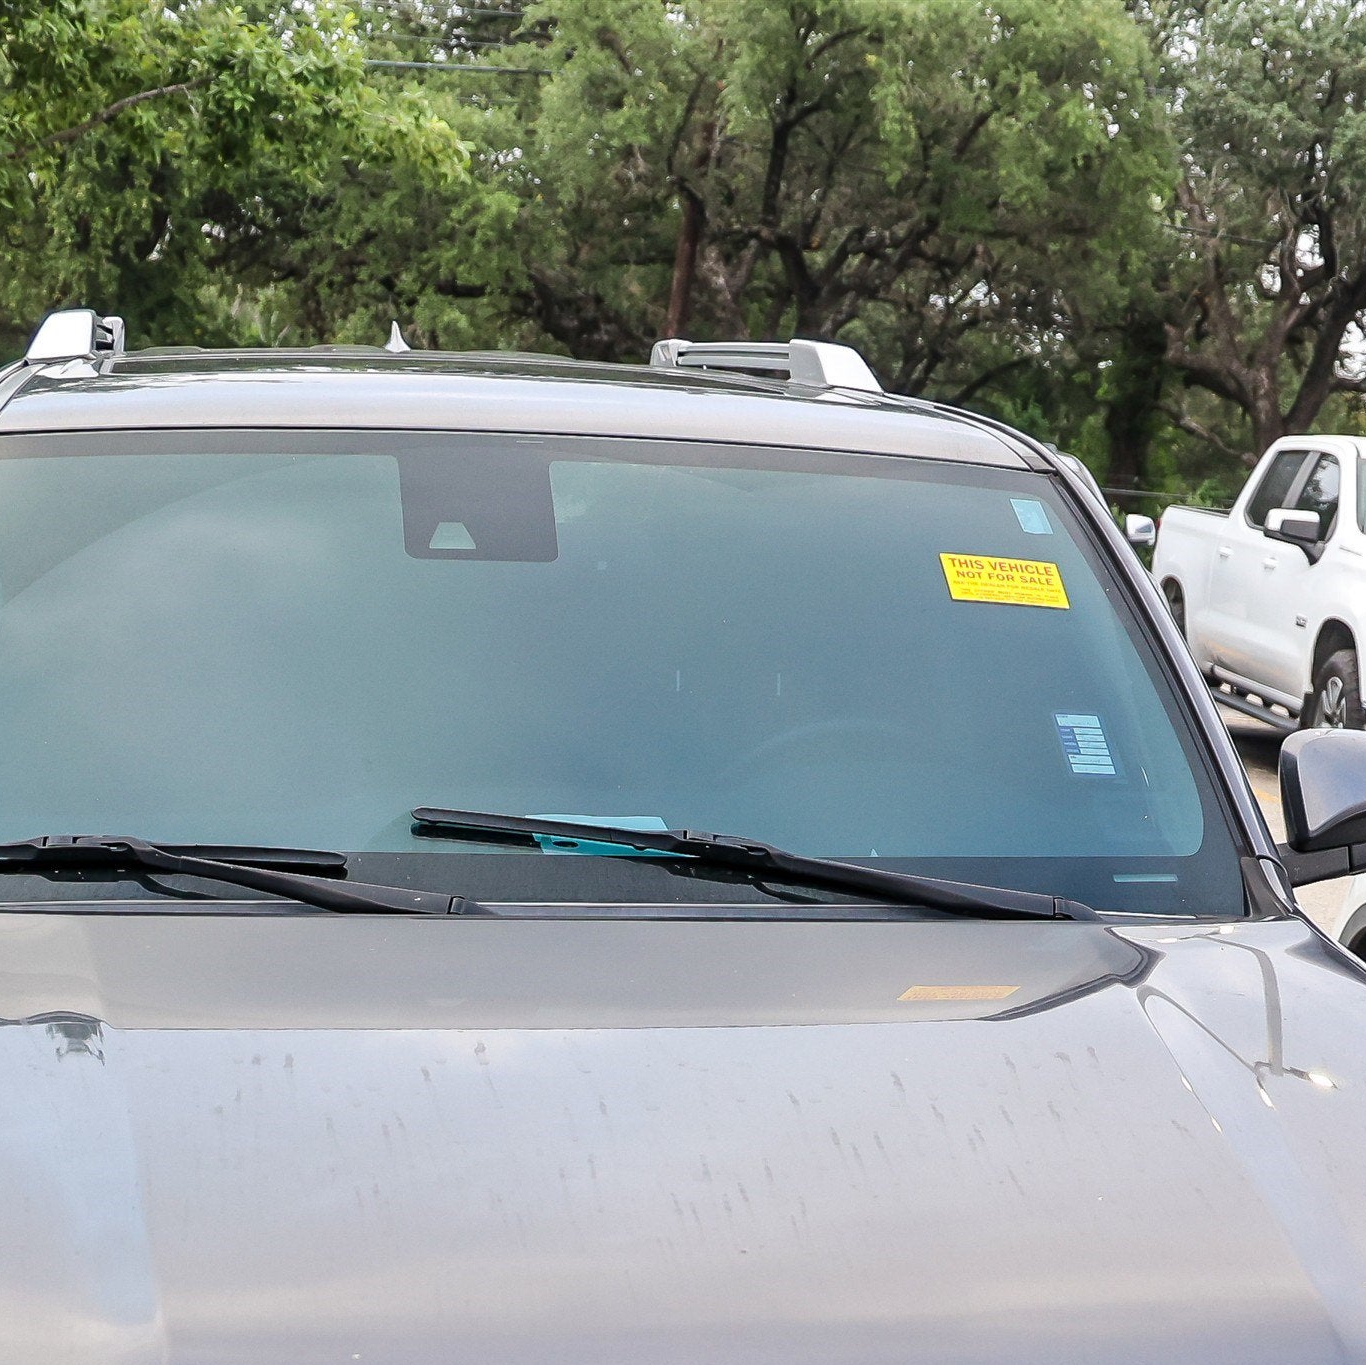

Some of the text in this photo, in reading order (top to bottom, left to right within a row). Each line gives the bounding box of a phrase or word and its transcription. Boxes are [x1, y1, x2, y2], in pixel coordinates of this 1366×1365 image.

[948, 557, 1054, 576] THIS VEHICLE
[956, 570, 1054, 586] NOT FOR SALE
